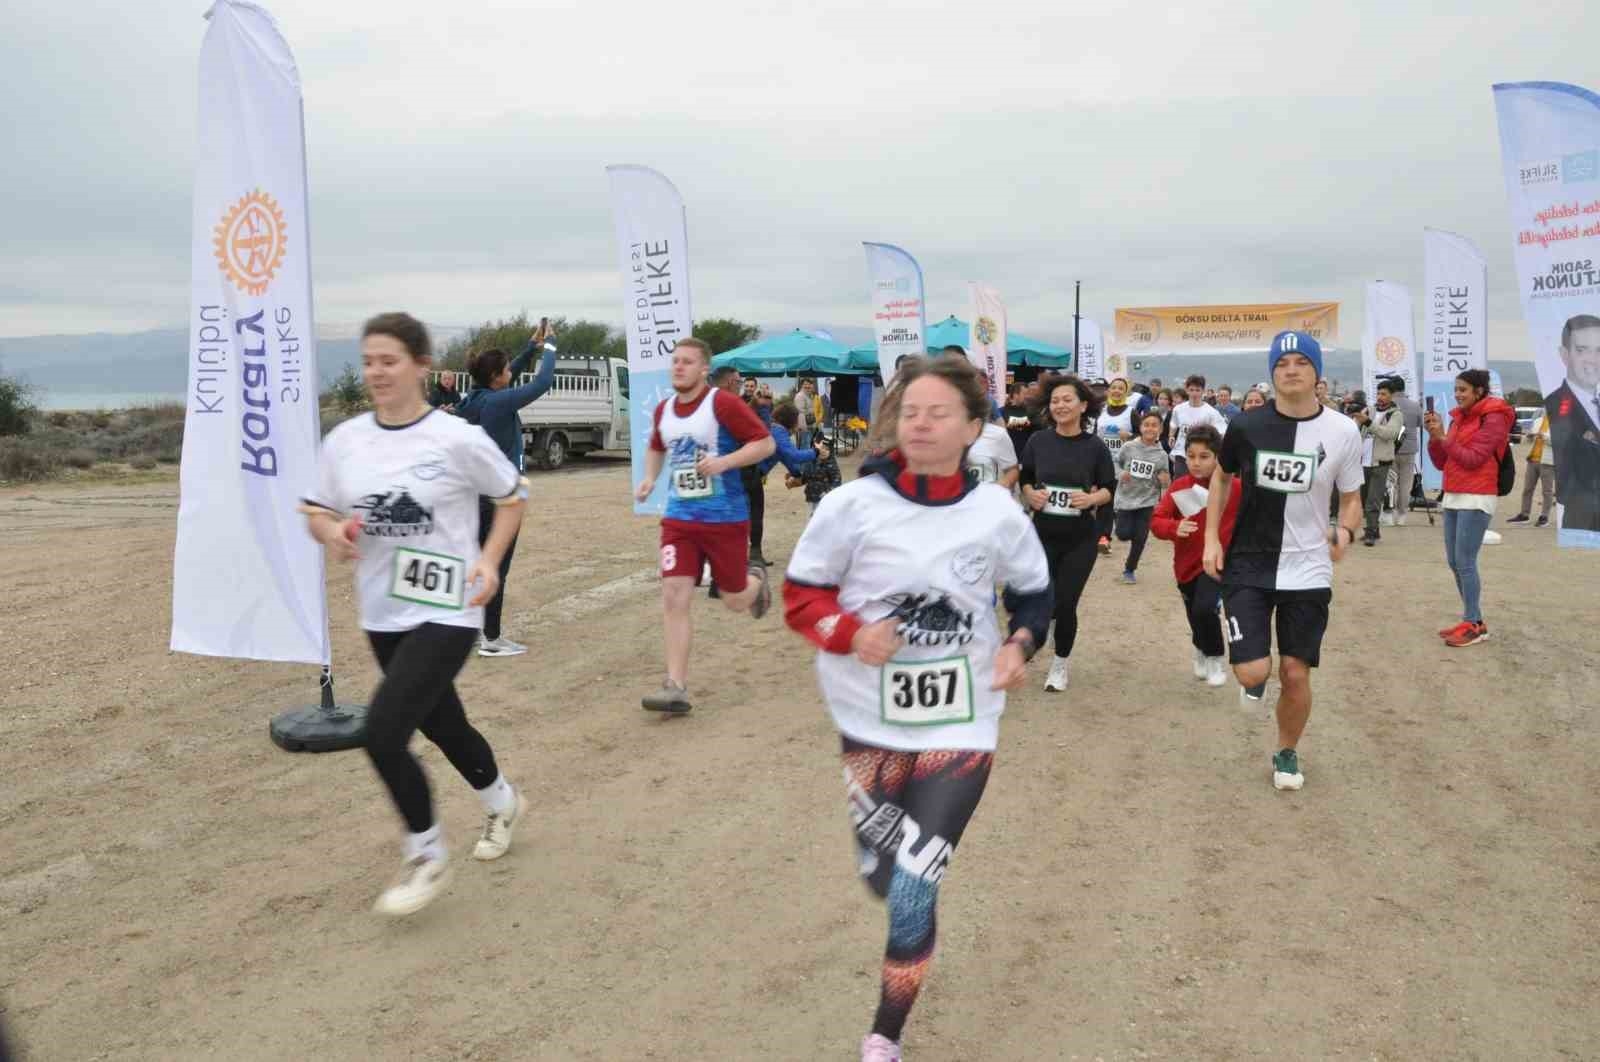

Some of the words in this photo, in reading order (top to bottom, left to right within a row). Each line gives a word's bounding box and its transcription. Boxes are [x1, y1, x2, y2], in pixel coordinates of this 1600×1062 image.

[1211, 314, 1241, 323] DELTA
[1243, 313, 1269, 322] TRAIL
[1132, 461, 1153, 475] 389
[1263, 458, 1306, 483] 452
[404, 559, 456, 594] 461
[892, 668, 958, 708] 367
